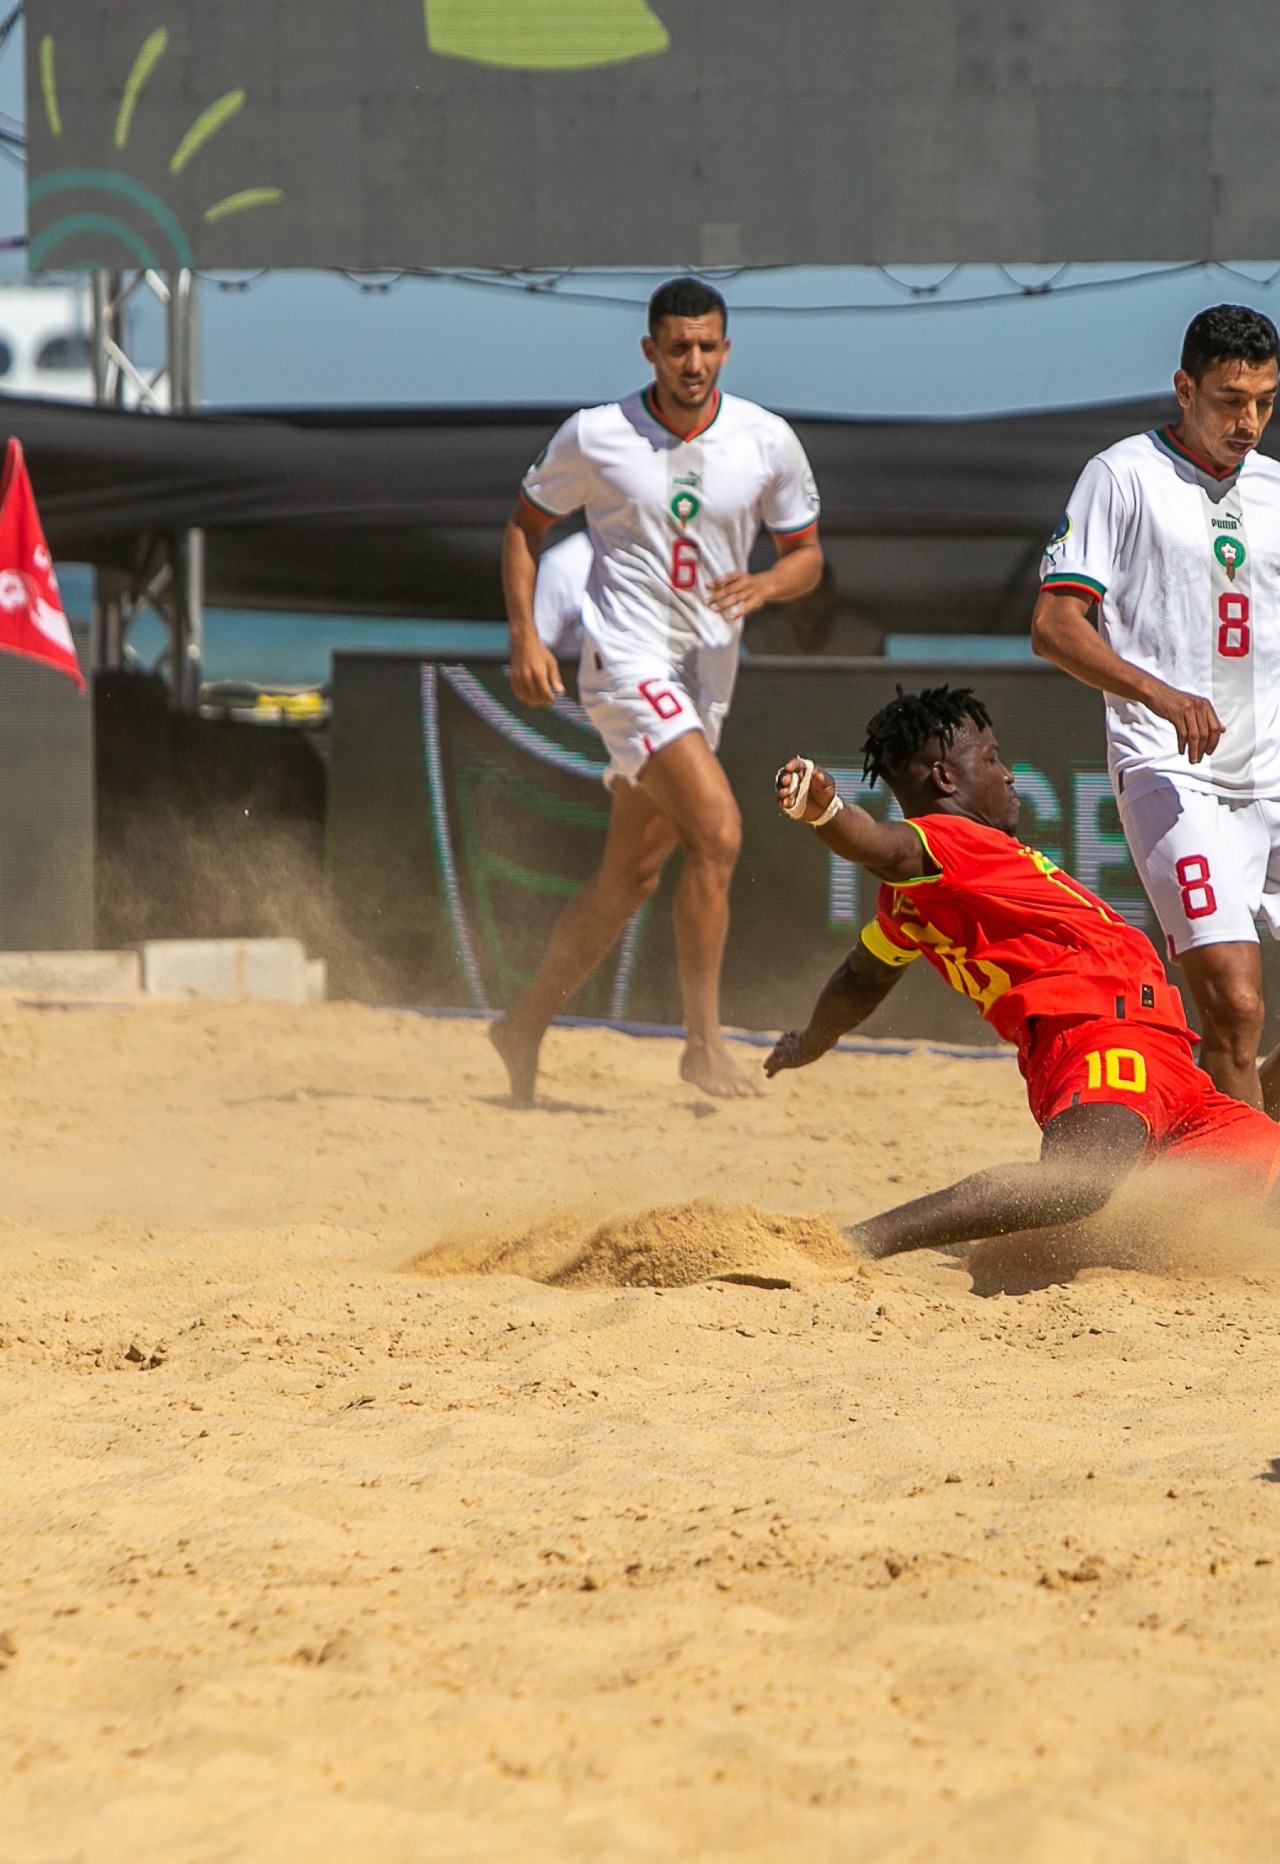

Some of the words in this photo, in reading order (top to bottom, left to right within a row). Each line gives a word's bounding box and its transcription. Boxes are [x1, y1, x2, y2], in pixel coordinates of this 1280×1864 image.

[1211, 518, 1238, 530] PUMA
[671, 537, 699, 590] 6
[1218, 592, 1250, 657] 8
[638, 678, 683, 720] 6
[1175, 854, 1218, 920] 8
[1085, 1047, 1147, 1093] 10
